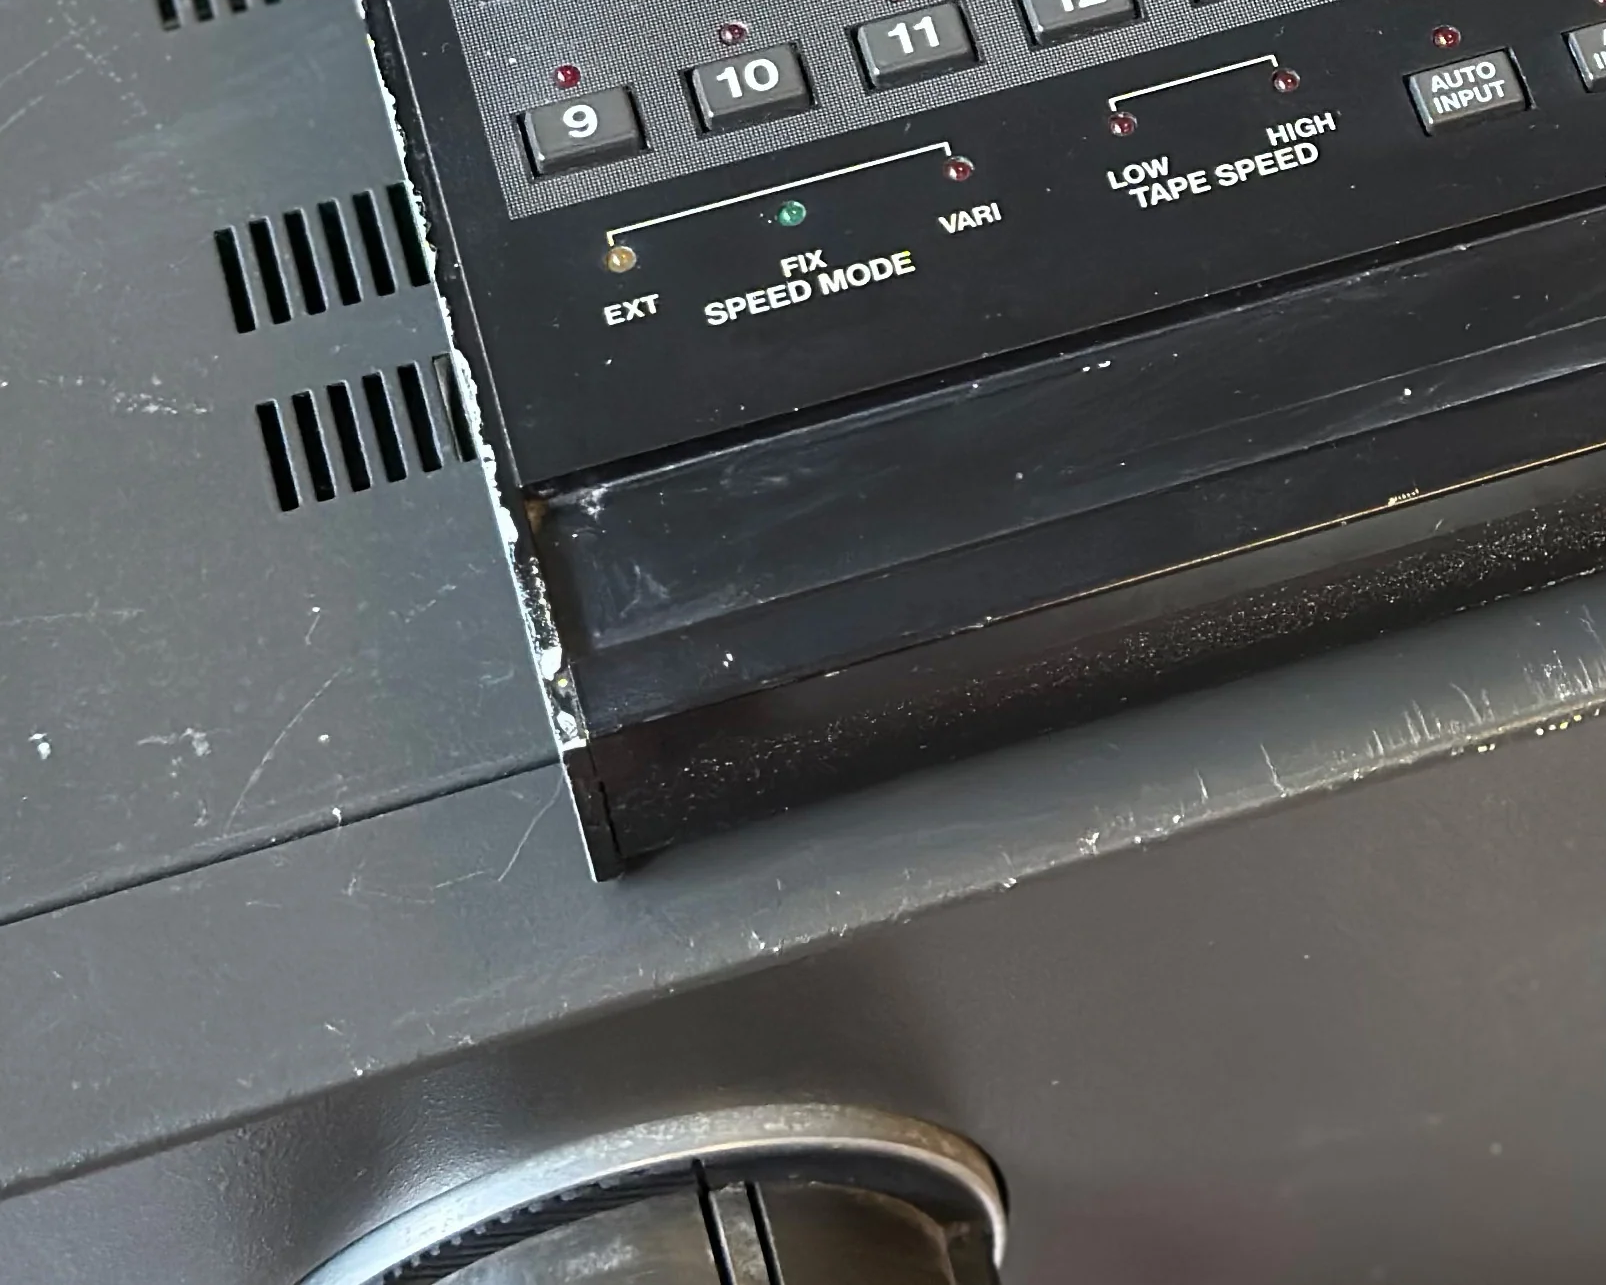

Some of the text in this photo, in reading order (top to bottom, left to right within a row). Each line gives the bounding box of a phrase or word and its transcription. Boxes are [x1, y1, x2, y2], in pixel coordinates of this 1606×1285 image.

[888, 16, 939, 53] 11
[716, 59, 778, 97] 10
[1432, 62, 1495, 92] AUTO
[1432, 81, 1505, 113] INPUT
[563, 105, 597, 137] 9
[1266, 113, 1335, 146] HIGH
[1107, 157, 1168, 189] LOW
[1129, 143, 1318, 207] TAPE SPEED
[938, 203, 1001, 233] VARI
[781, 250, 827, 277] FIX
[705, 251, 915, 325] SPEED MODE
[604, 294, 658, 325] EXT
